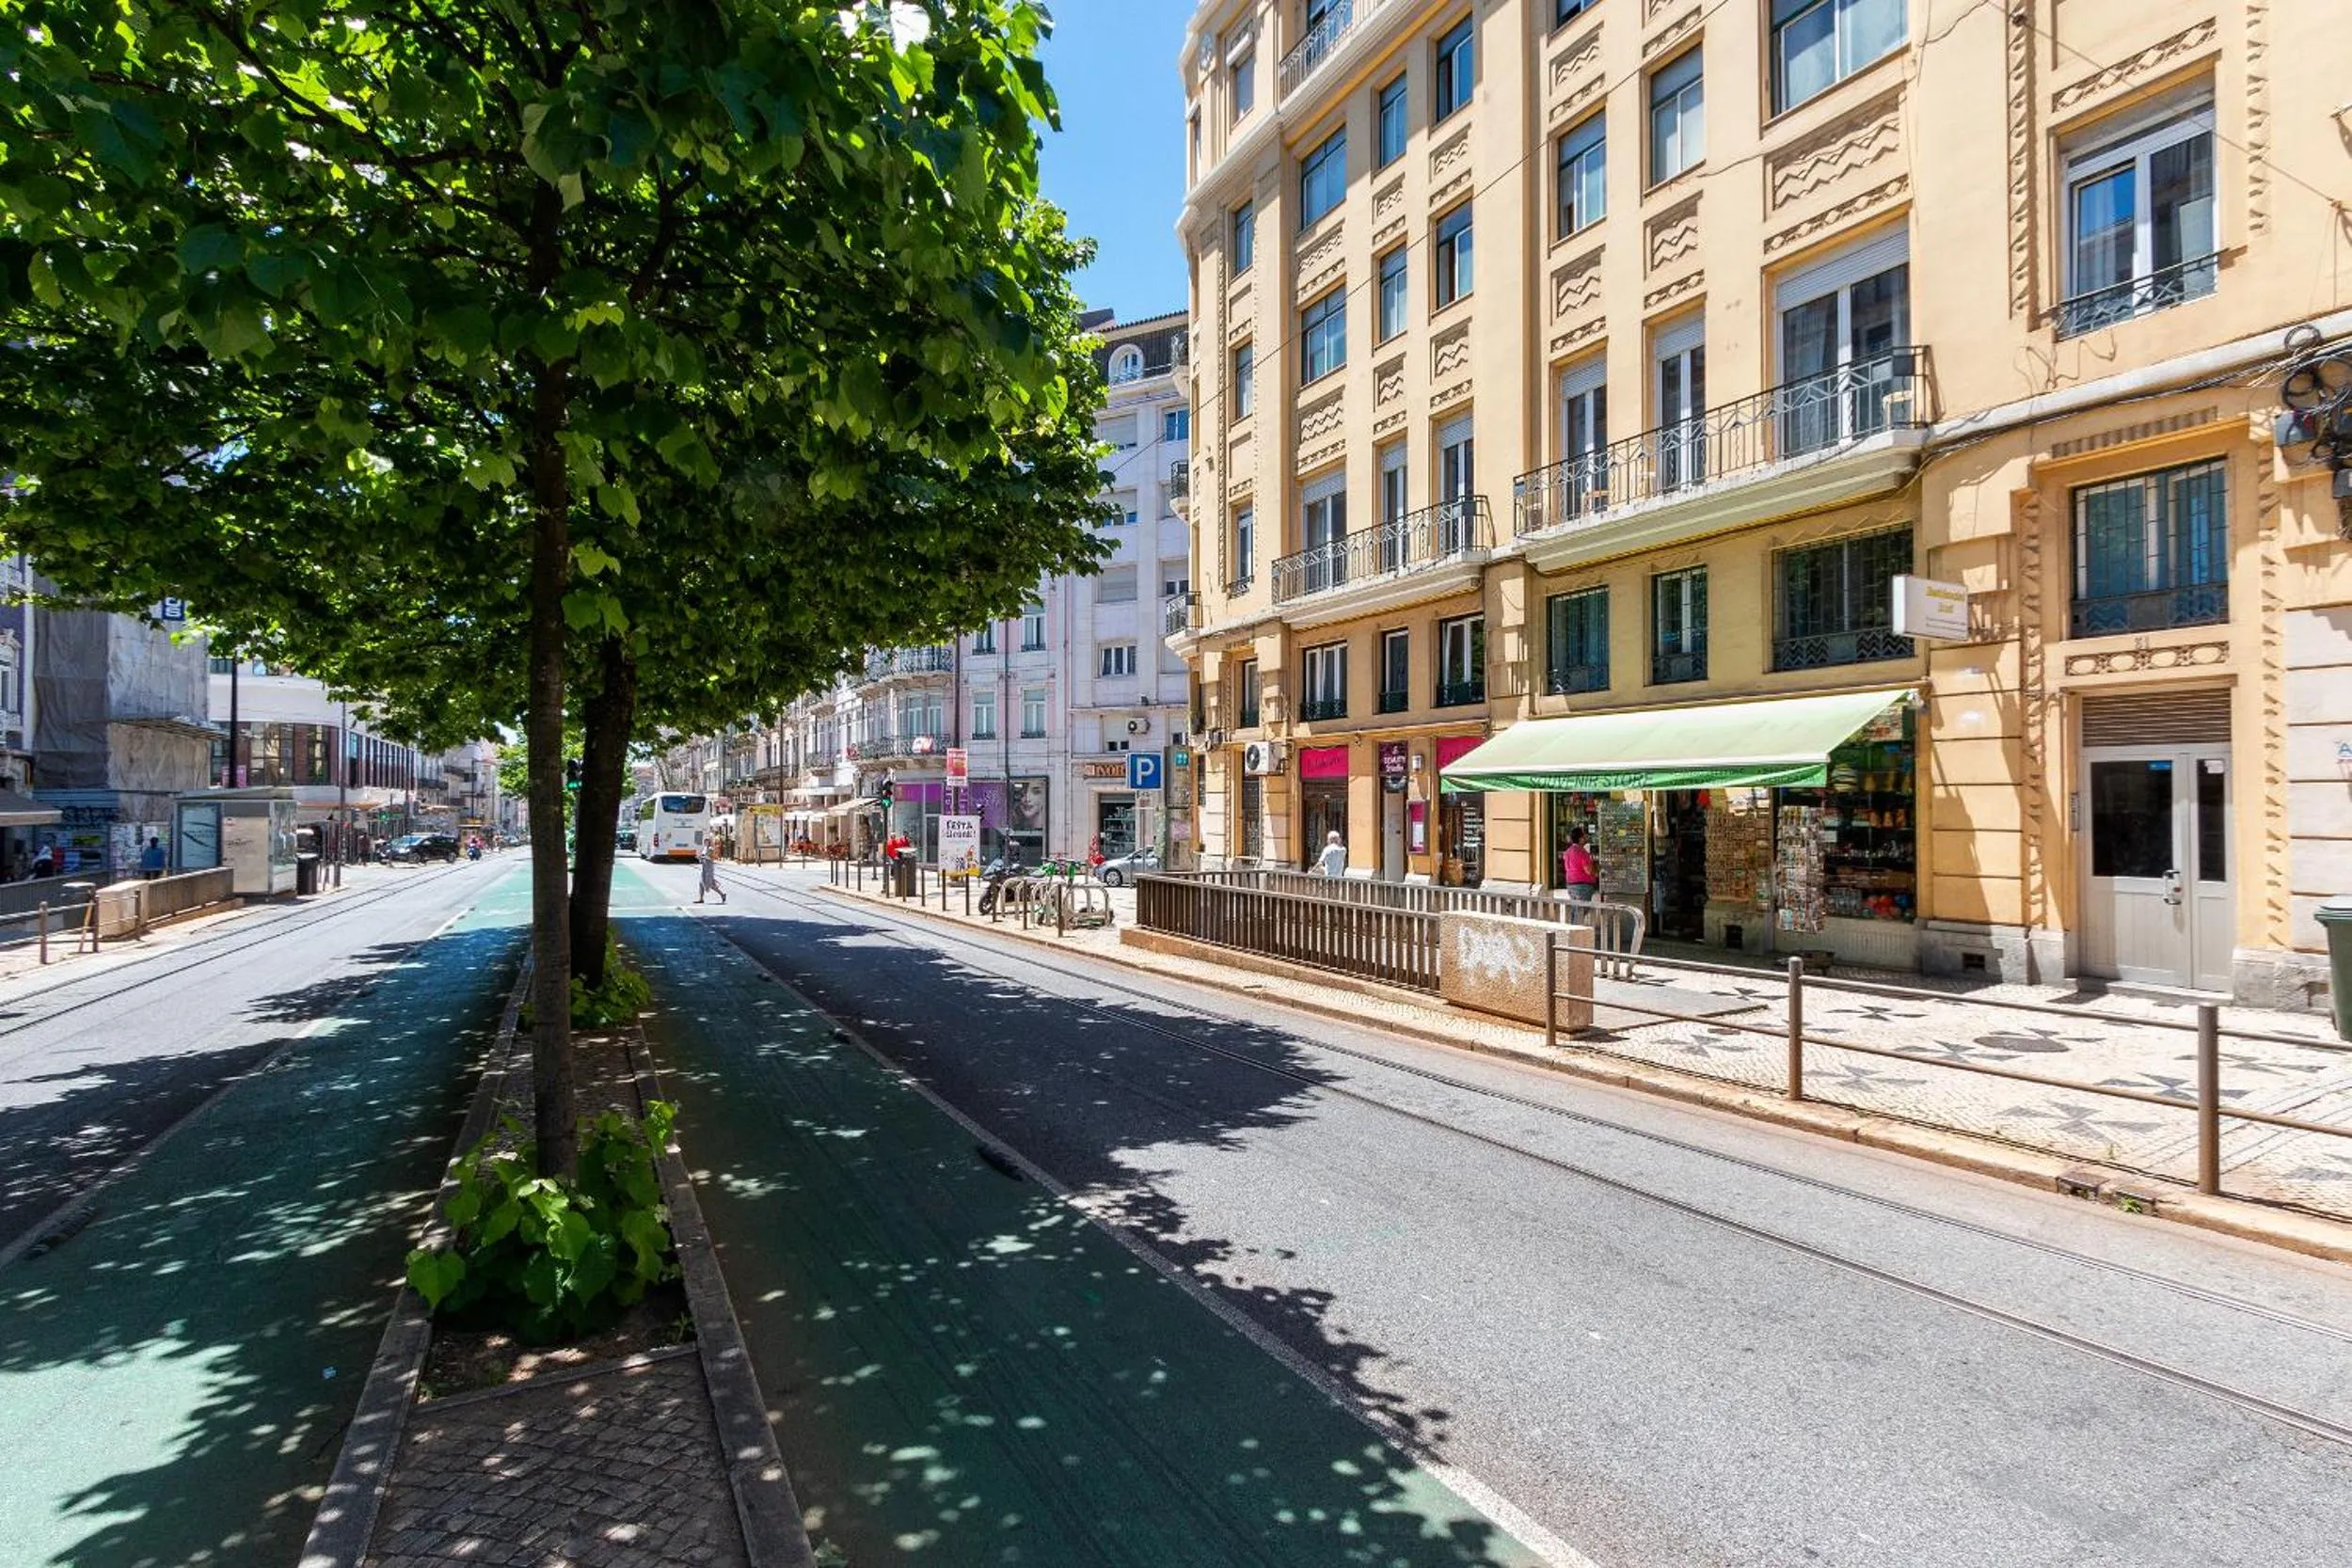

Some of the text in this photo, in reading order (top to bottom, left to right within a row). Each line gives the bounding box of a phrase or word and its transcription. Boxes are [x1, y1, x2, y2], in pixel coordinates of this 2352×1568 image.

[1136, 756, 1155, 785] P
[1530, 774, 1599, 788] SOUVENIR
[946, 819, 974, 830] FESTA
